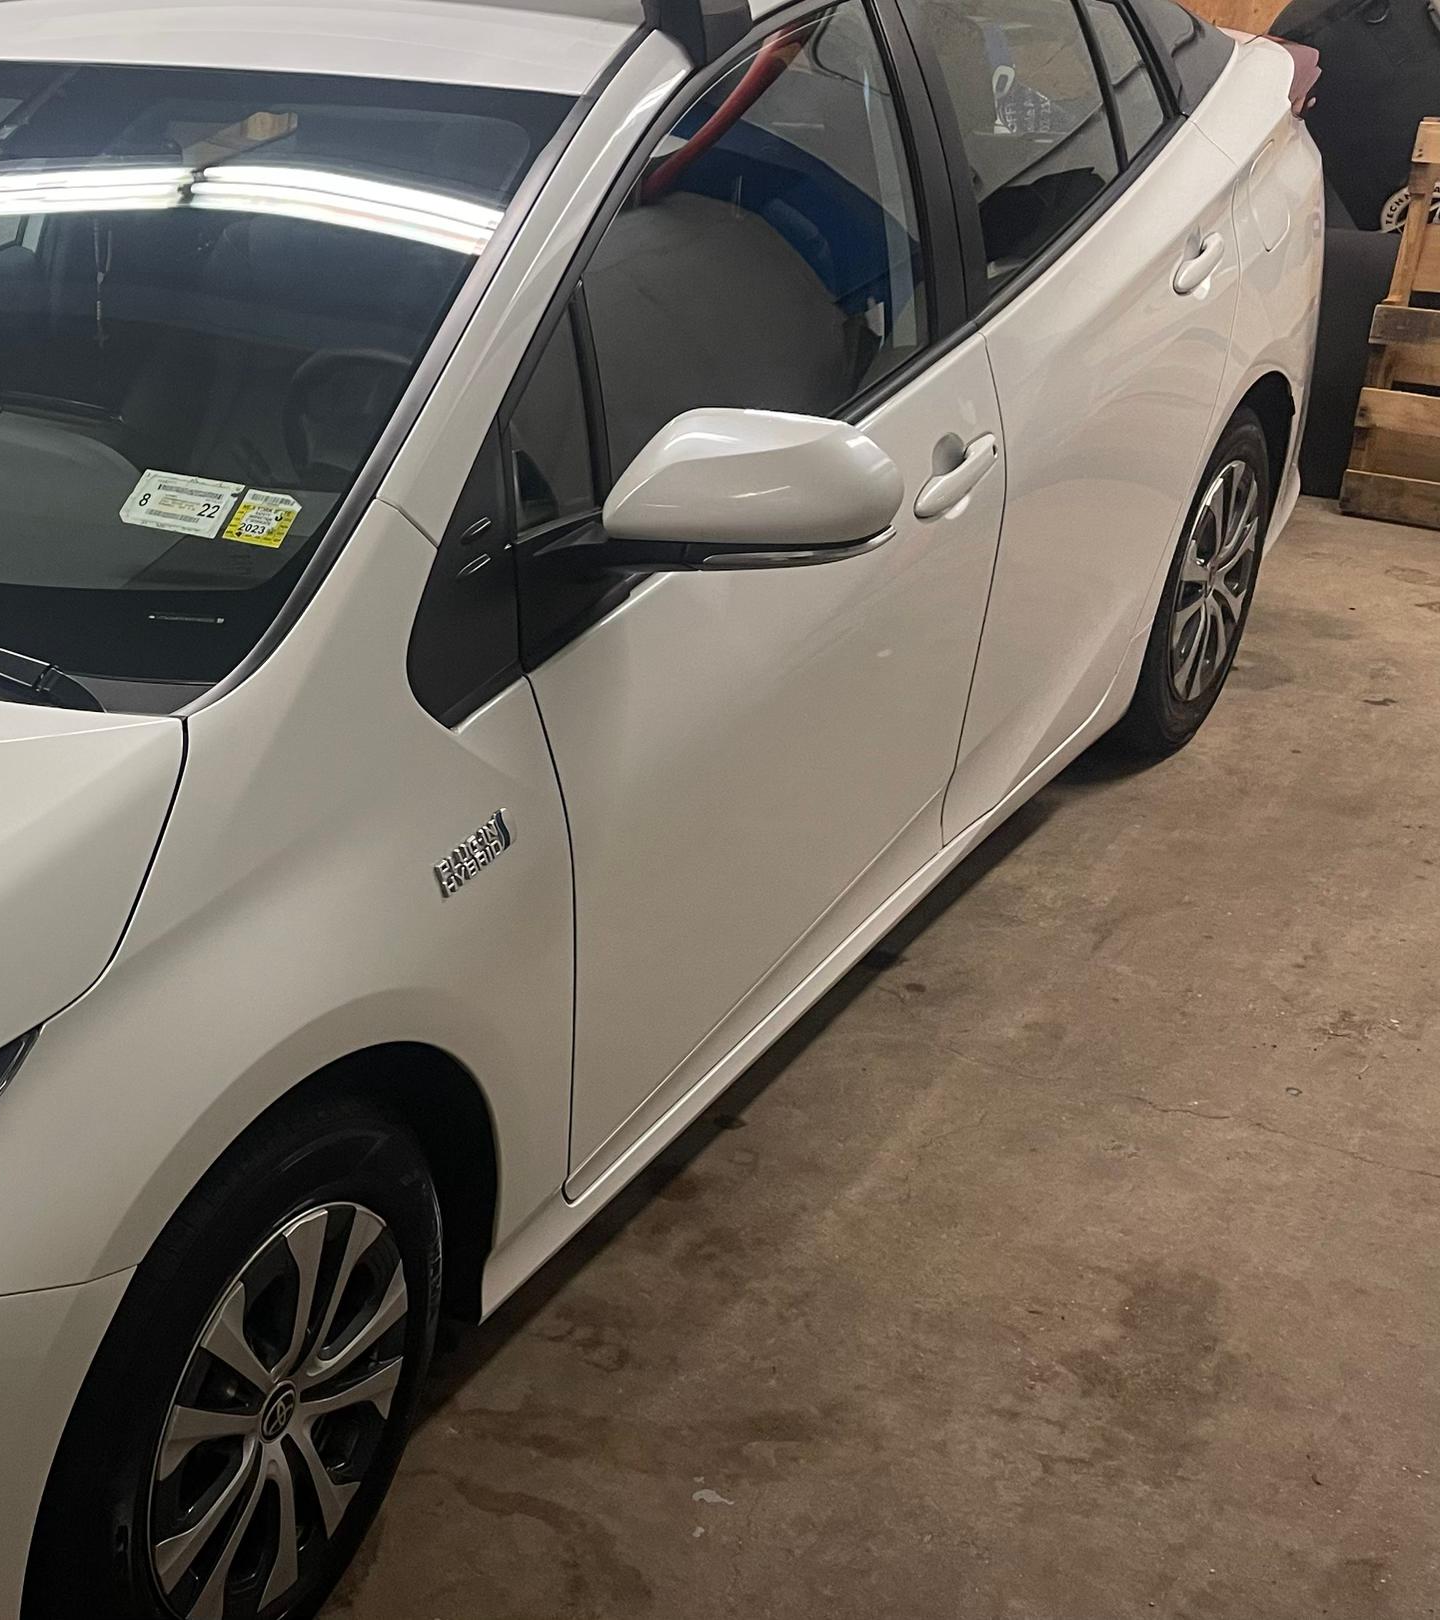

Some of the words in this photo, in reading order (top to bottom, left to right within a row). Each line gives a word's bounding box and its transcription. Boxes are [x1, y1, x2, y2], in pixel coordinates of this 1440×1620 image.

[138, 493, 152, 507] 8
[197, 502, 221, 519] 22
[237, 522, 266, 535] 2023
